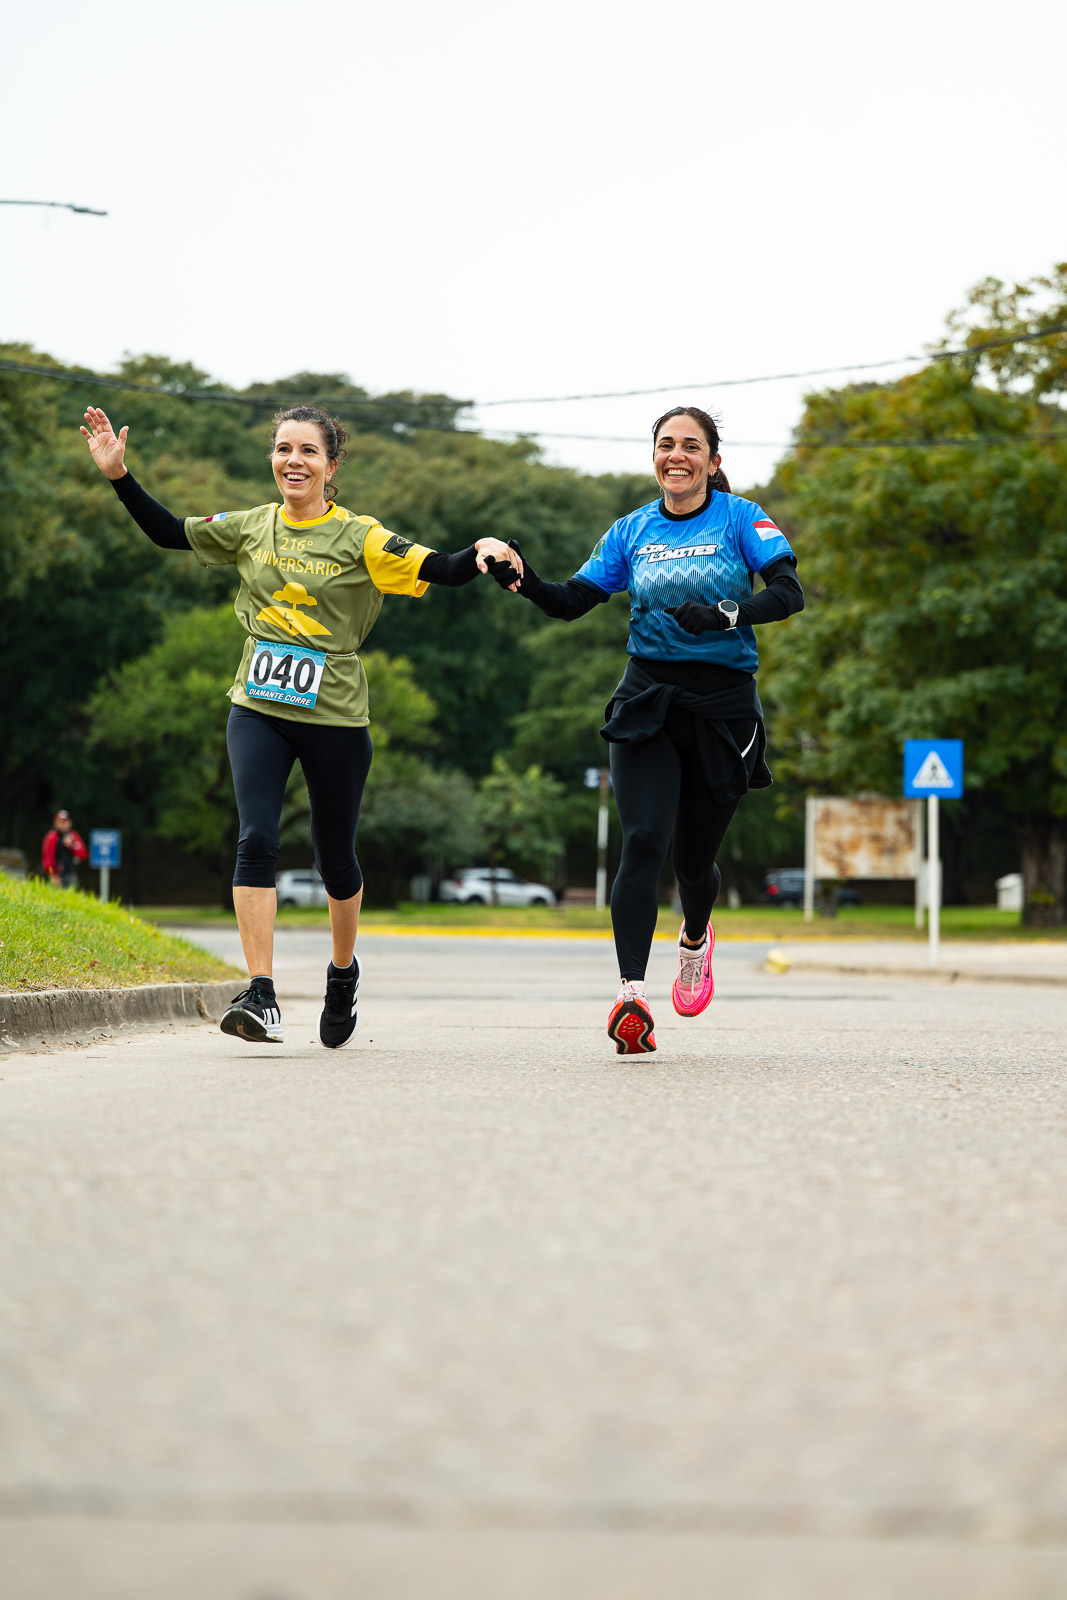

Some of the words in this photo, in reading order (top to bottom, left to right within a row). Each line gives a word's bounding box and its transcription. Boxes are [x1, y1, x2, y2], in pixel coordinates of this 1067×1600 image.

[281, 537, 313, 551] 216°
[637, 544, 669, 555] SIN
[648, 544, 718, 563] LIMITES
[253, 549, 341, 577] ANIVERSARIO
[253, 650, 316, 694] 040
[248, 688, 284, 700] DIAMANTE
[284, 694, 312, 706] CORRE
